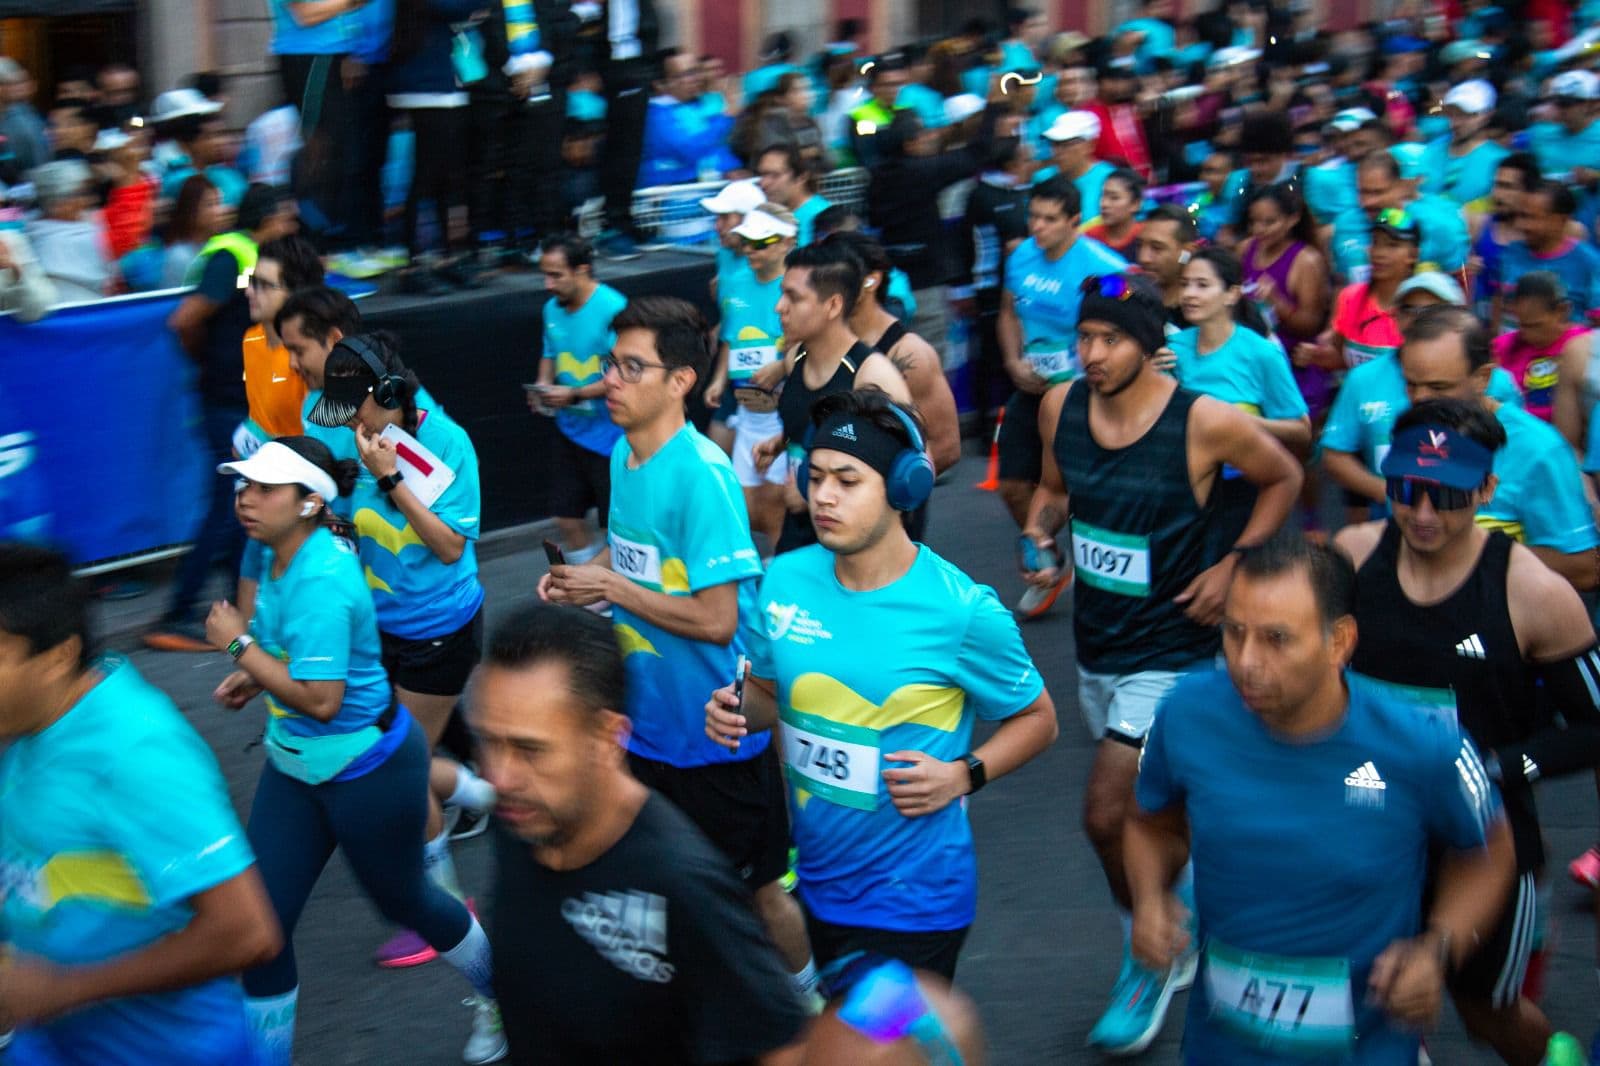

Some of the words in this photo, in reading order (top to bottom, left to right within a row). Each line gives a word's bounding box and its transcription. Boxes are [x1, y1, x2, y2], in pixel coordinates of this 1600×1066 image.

[1080, 542, 1134, 576] 1097
[797, 737, 849, 780] 748
[1344, 776, 1386, 790] adidas
